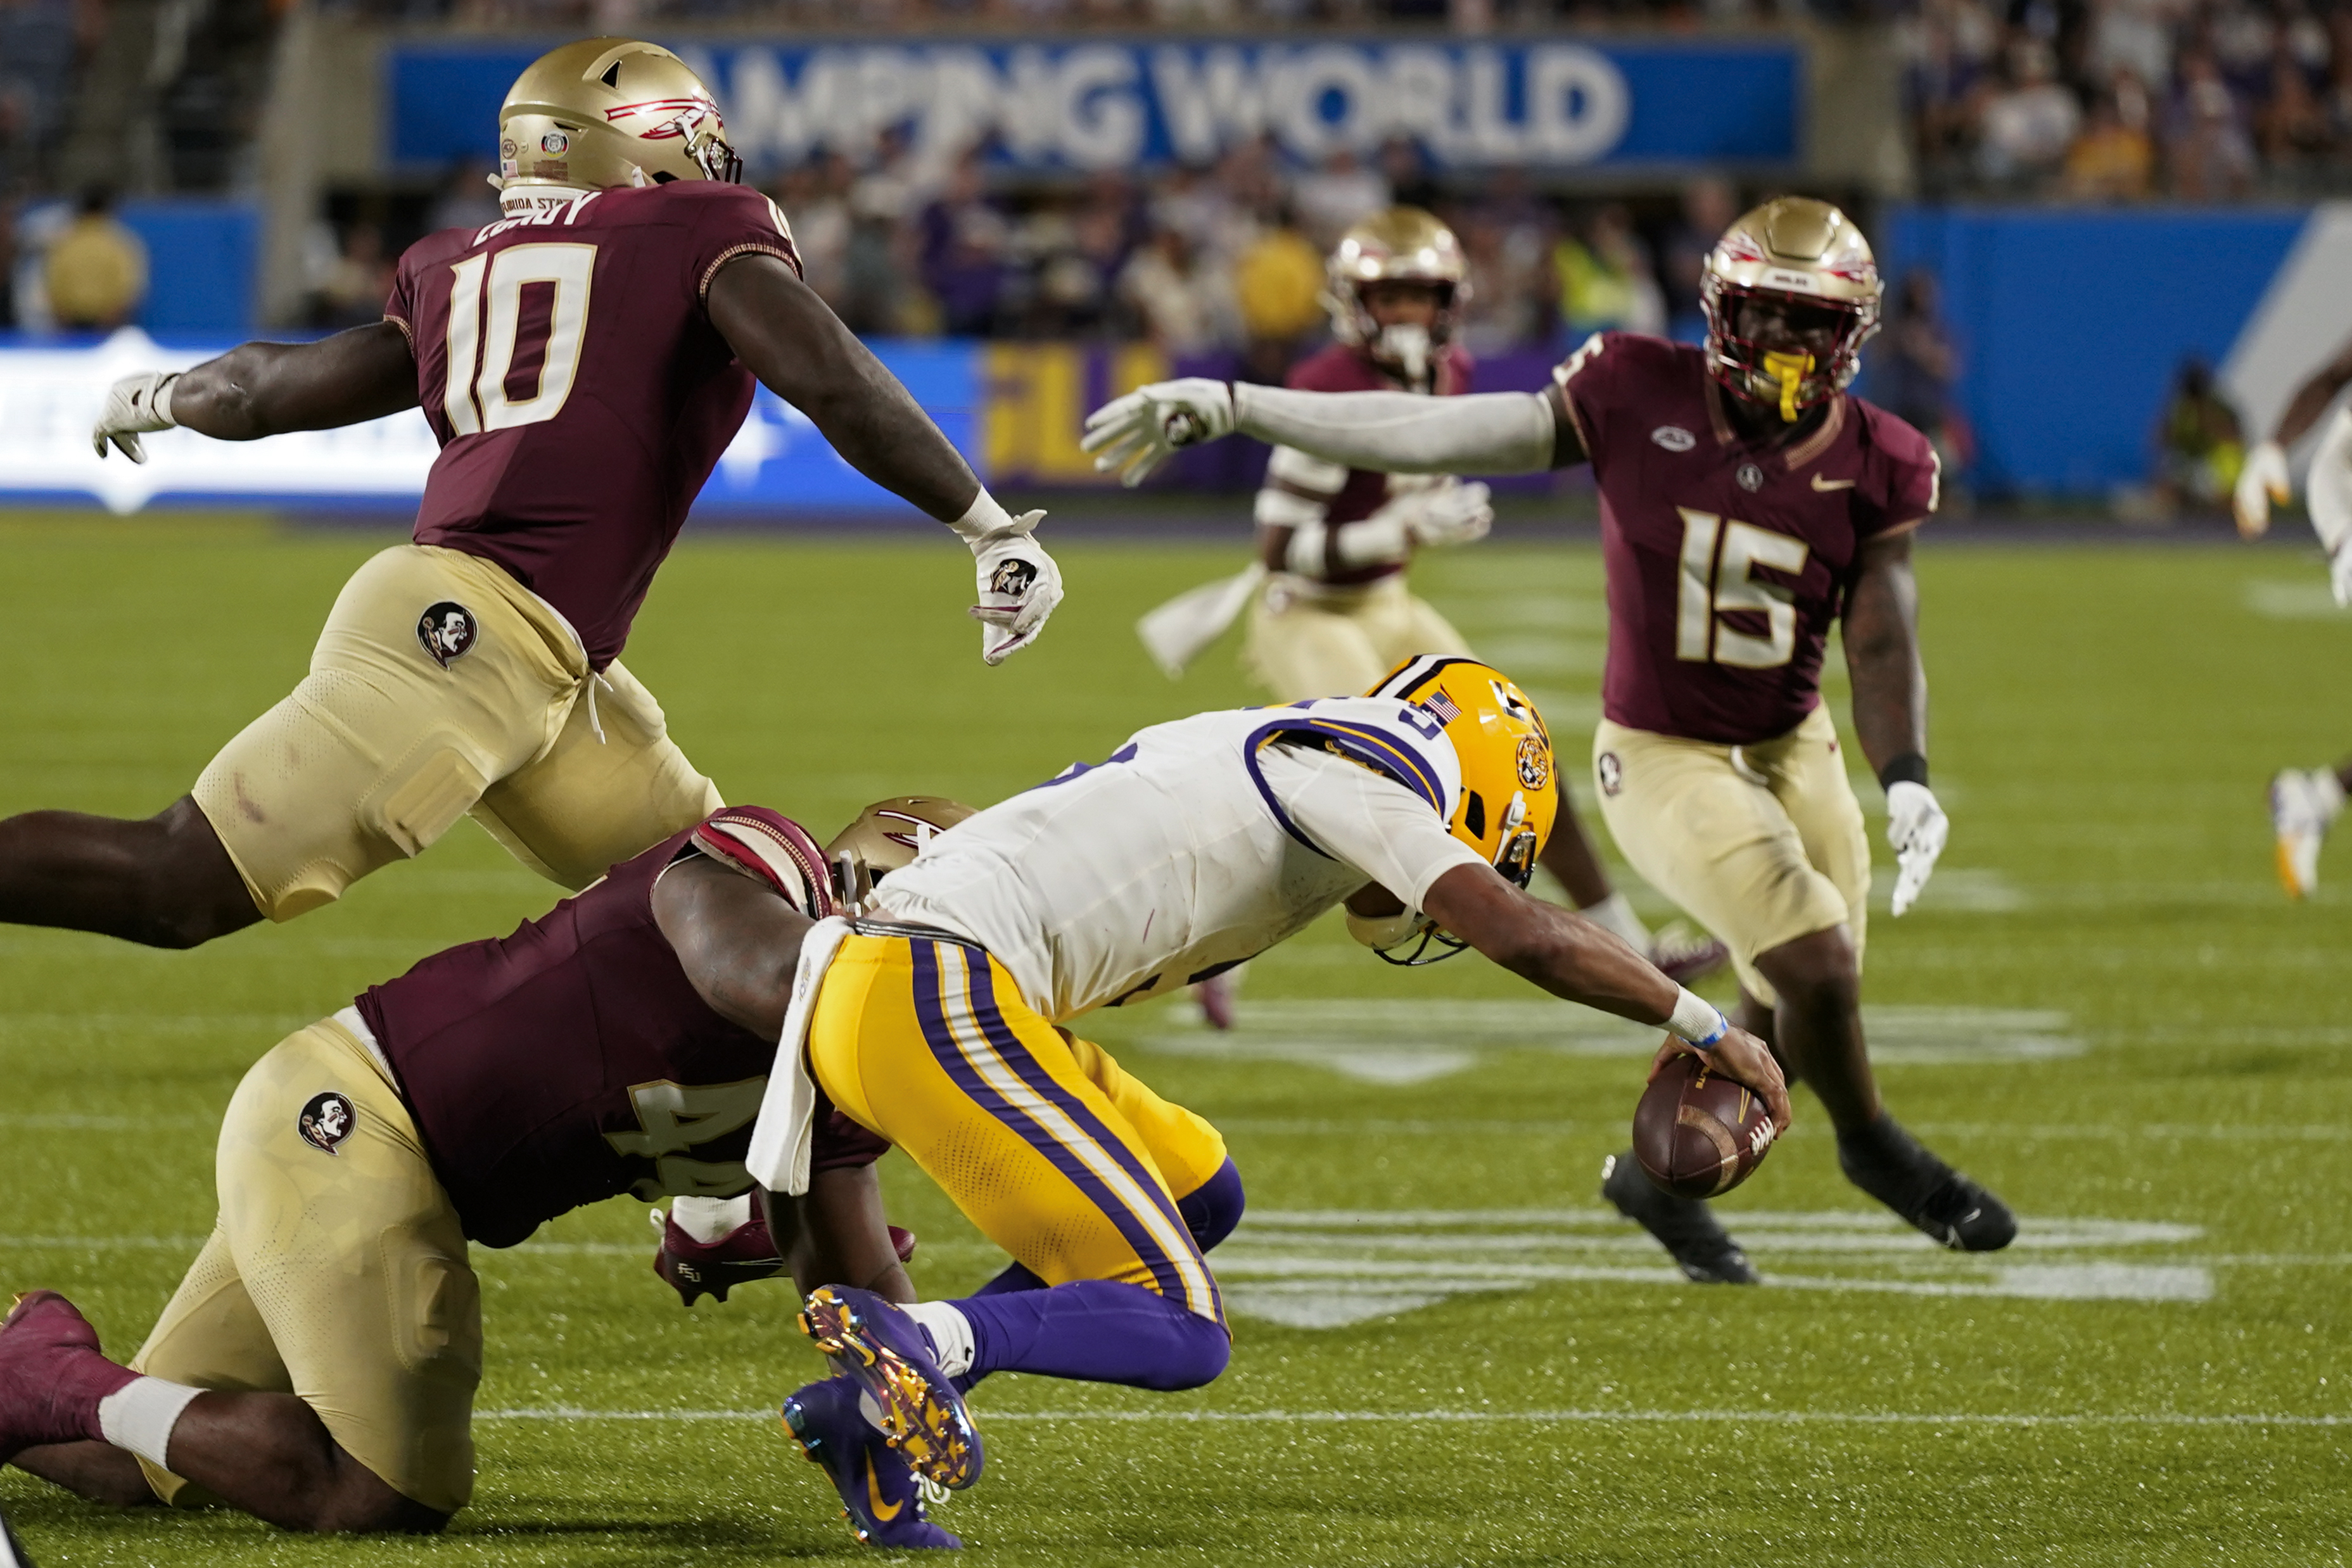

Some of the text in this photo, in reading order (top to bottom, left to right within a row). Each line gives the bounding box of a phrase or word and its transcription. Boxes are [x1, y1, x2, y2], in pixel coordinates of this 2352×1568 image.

[1148, 43, 1636, 170] WORLD
[445, 242, 599, 438] 10
[1675, 505, 1810, 670] 15
